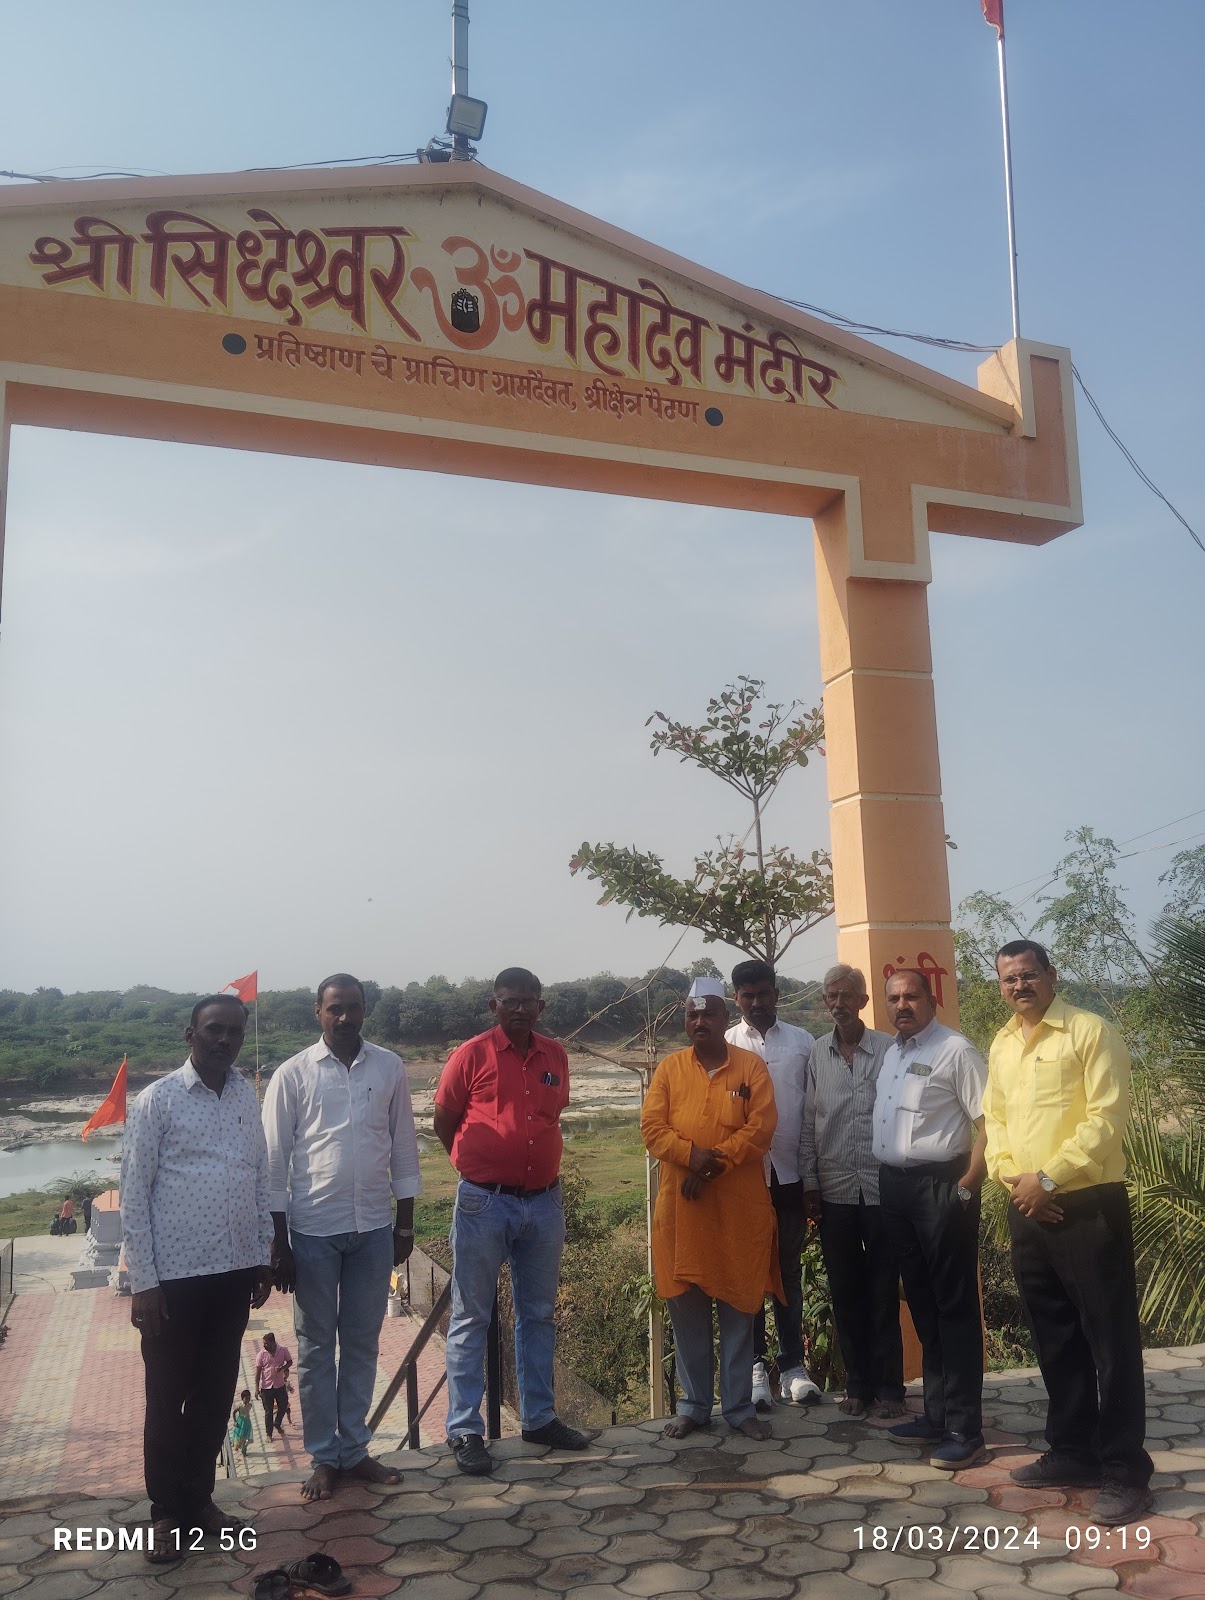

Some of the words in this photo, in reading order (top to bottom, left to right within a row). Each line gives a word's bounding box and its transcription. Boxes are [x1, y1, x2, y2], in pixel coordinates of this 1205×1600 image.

[522, 247, 713, 386] महादेव
[371, 344, 398, 382] चे
[402, 355, 489, 395] प्राचिण
